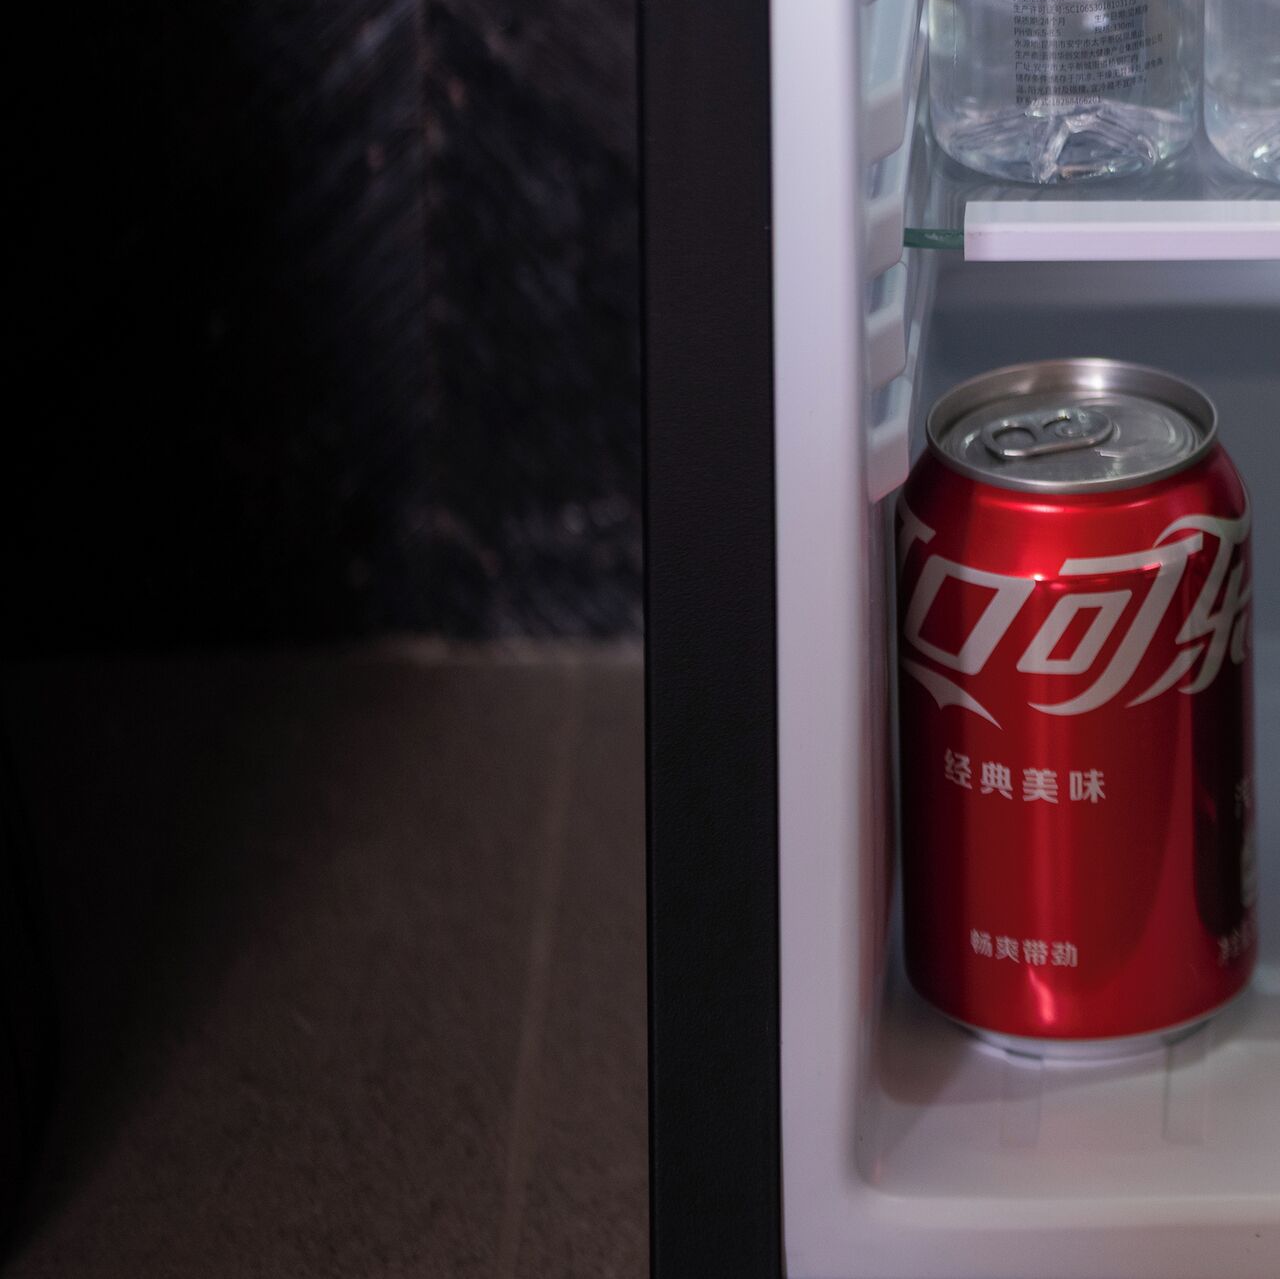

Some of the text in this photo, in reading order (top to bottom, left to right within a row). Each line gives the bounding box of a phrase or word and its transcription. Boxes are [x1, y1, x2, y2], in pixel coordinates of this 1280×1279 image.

[944, 747, 1107, 804] 经典美味
[969, 927, 1079, 969] 畅爽带劲
